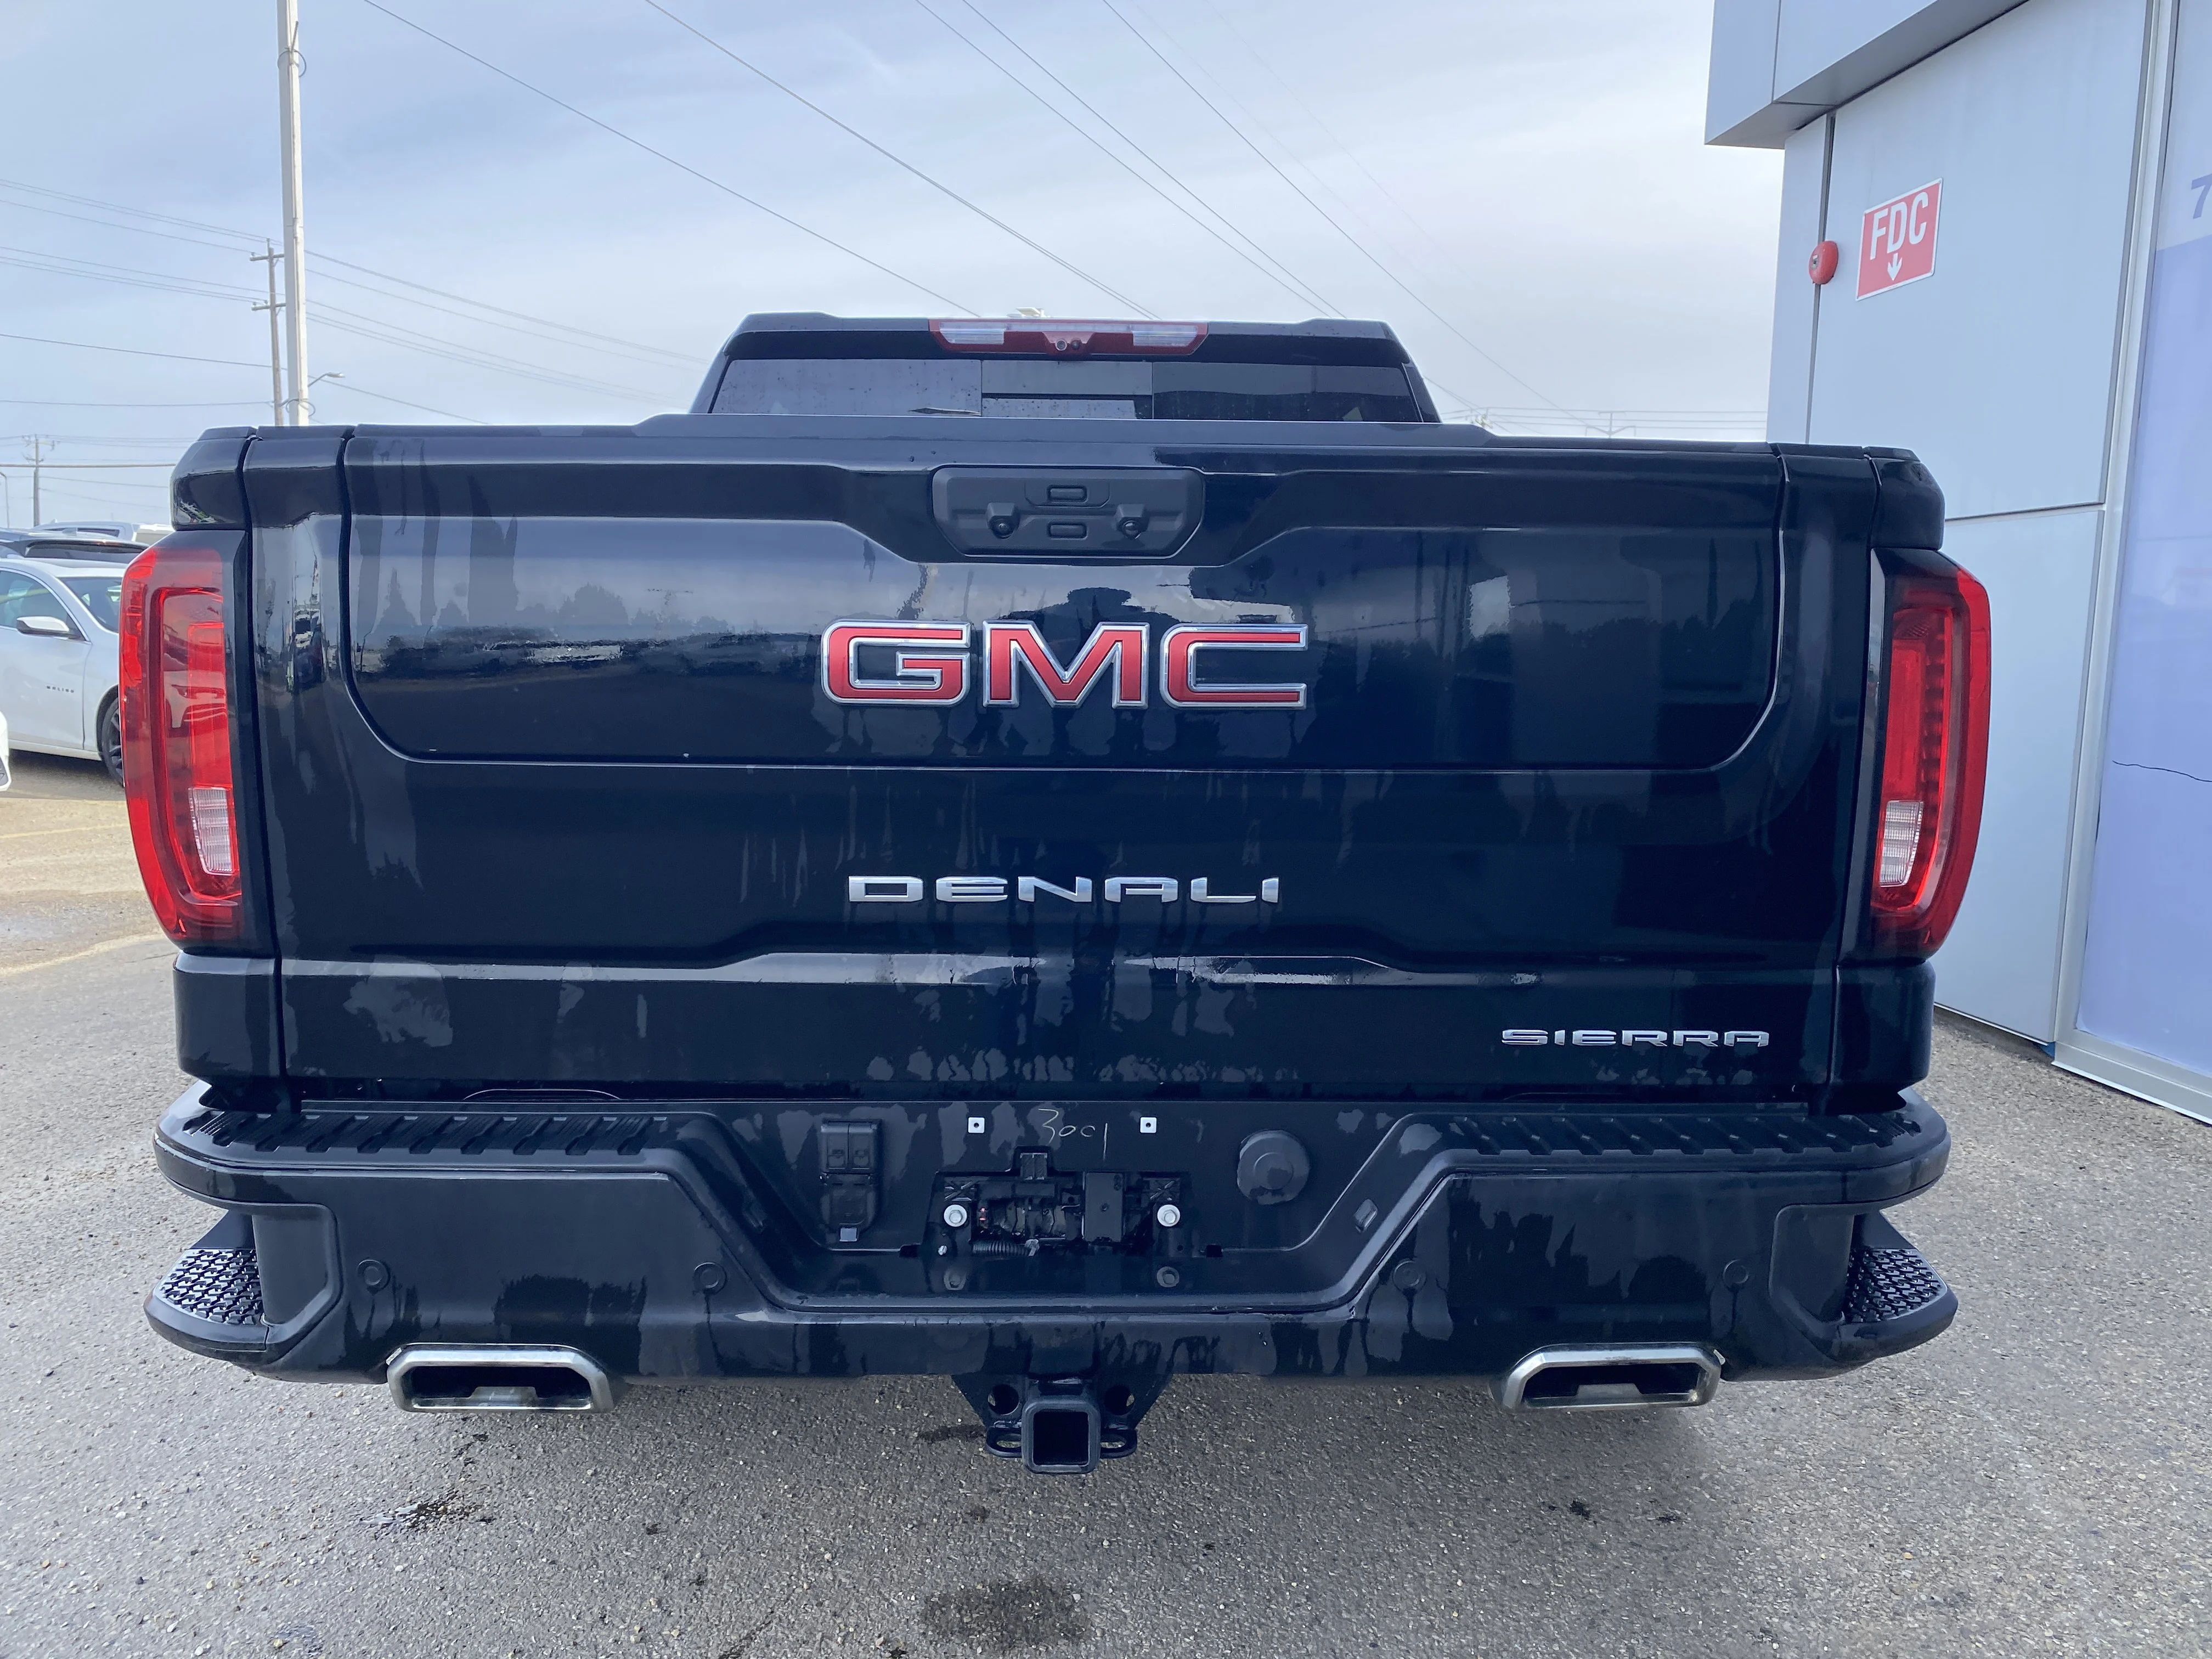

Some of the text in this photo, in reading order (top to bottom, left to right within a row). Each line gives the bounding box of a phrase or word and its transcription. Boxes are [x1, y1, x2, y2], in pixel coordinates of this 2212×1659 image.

[1870, 191, 1928, 261] FDC
[821, 620, 1308, 709] GMC
[849, 876, 1279, 903] DENALI
[1502, 1029, 1769, 1047] SIERRA
[1038, 1108, 1108, 1160] 3001
